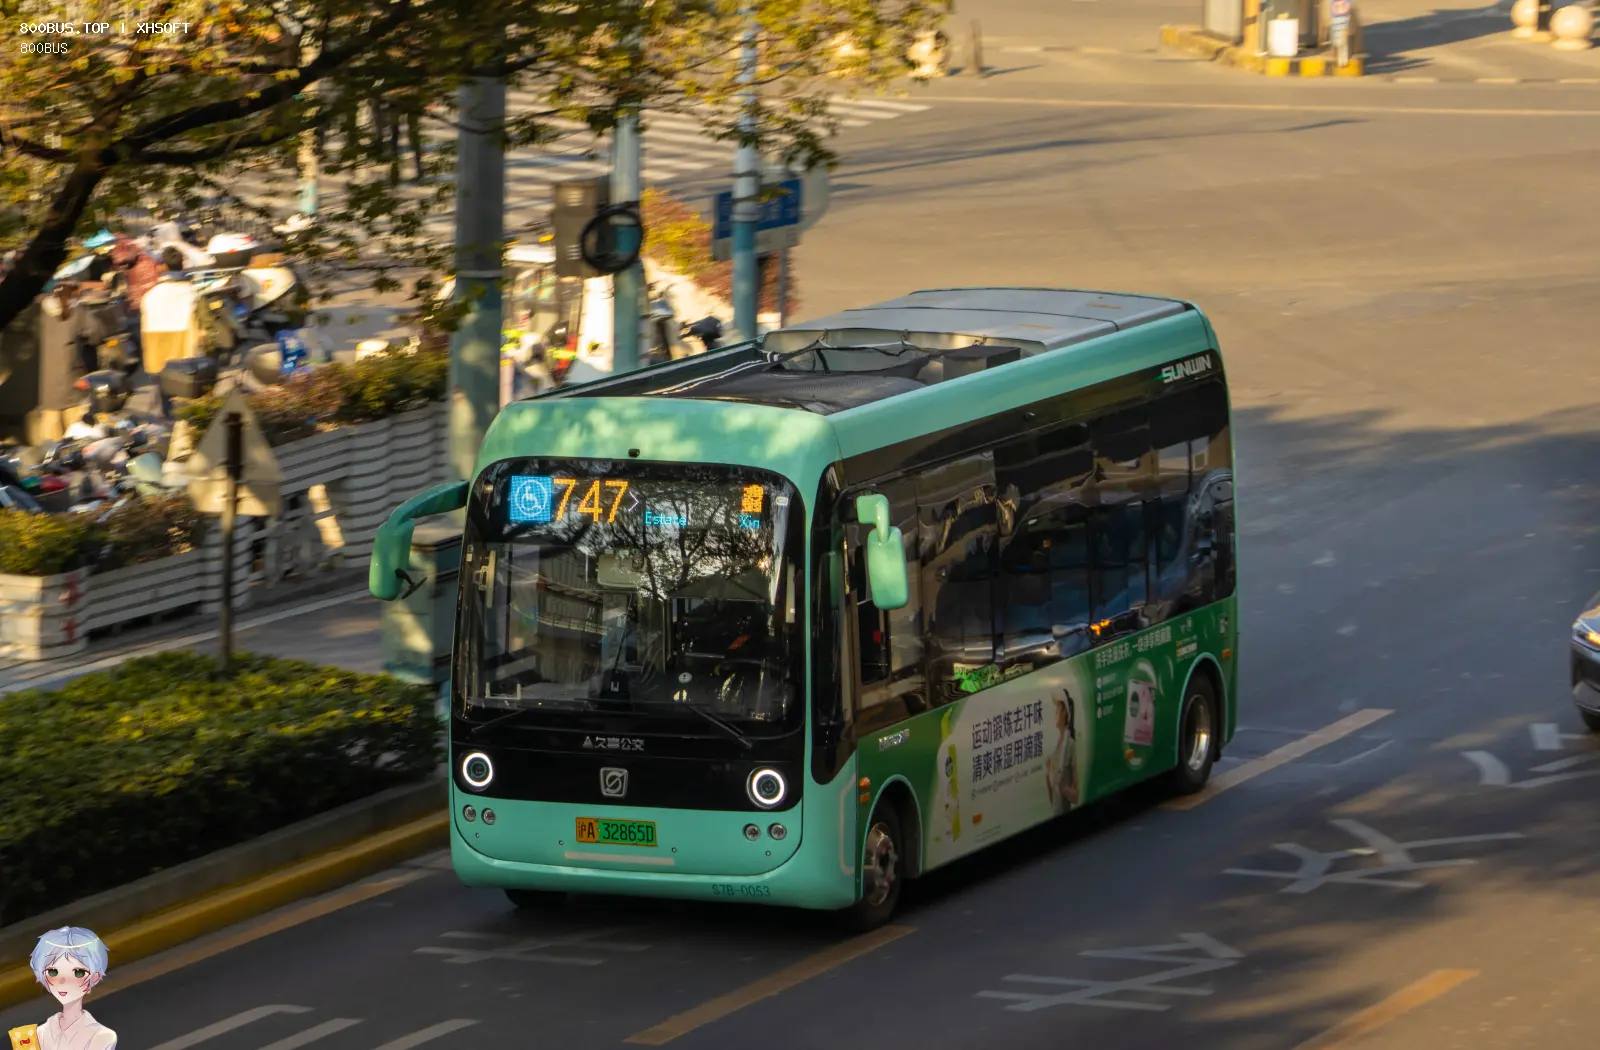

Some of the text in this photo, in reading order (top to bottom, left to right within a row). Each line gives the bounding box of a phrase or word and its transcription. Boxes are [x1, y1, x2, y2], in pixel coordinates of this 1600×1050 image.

[1161, 354, 1212, 384] SUNWIN
[553, 478, 629, 523] 747
[972, 699, 1044, 750] 运动锻炼去汗味
[972, 731, 1044, 784] 清爽保湿用滴露
[711, 884, 771, 898] S7B-0053
